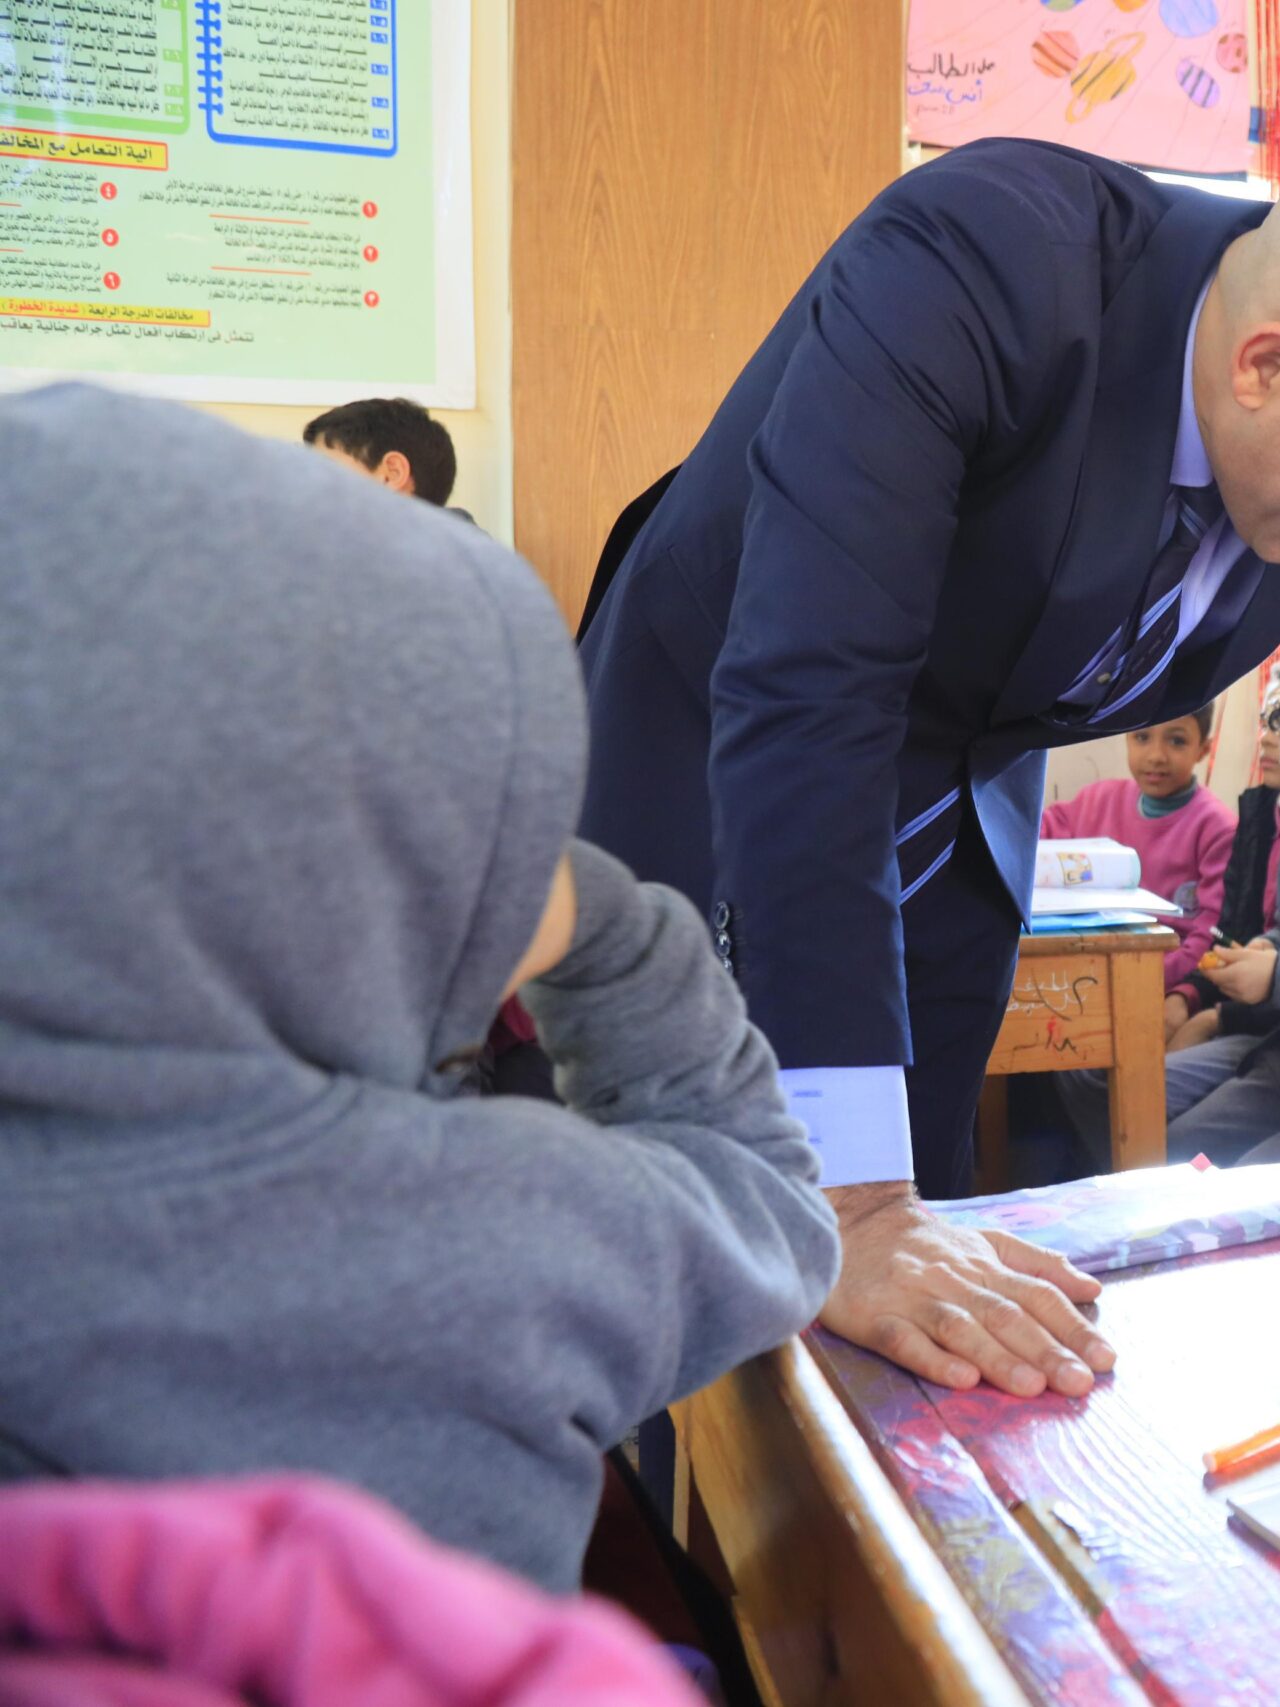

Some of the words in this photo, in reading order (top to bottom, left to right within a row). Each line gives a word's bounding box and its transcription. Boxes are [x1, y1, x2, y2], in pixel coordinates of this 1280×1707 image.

[907, 52, 976, 80] الطالب
[0, 133, 45, 150] المخالف
[48, 139, 66, 155] مع
[70, 141, 123, 157] التعامل
[8, 300, 46, 312] الخطورة
[88, 303, 120, 318] الرابعة
[122, 305, 154, 320] الدرجة
[155, 308, 194, 321] مخالفات
